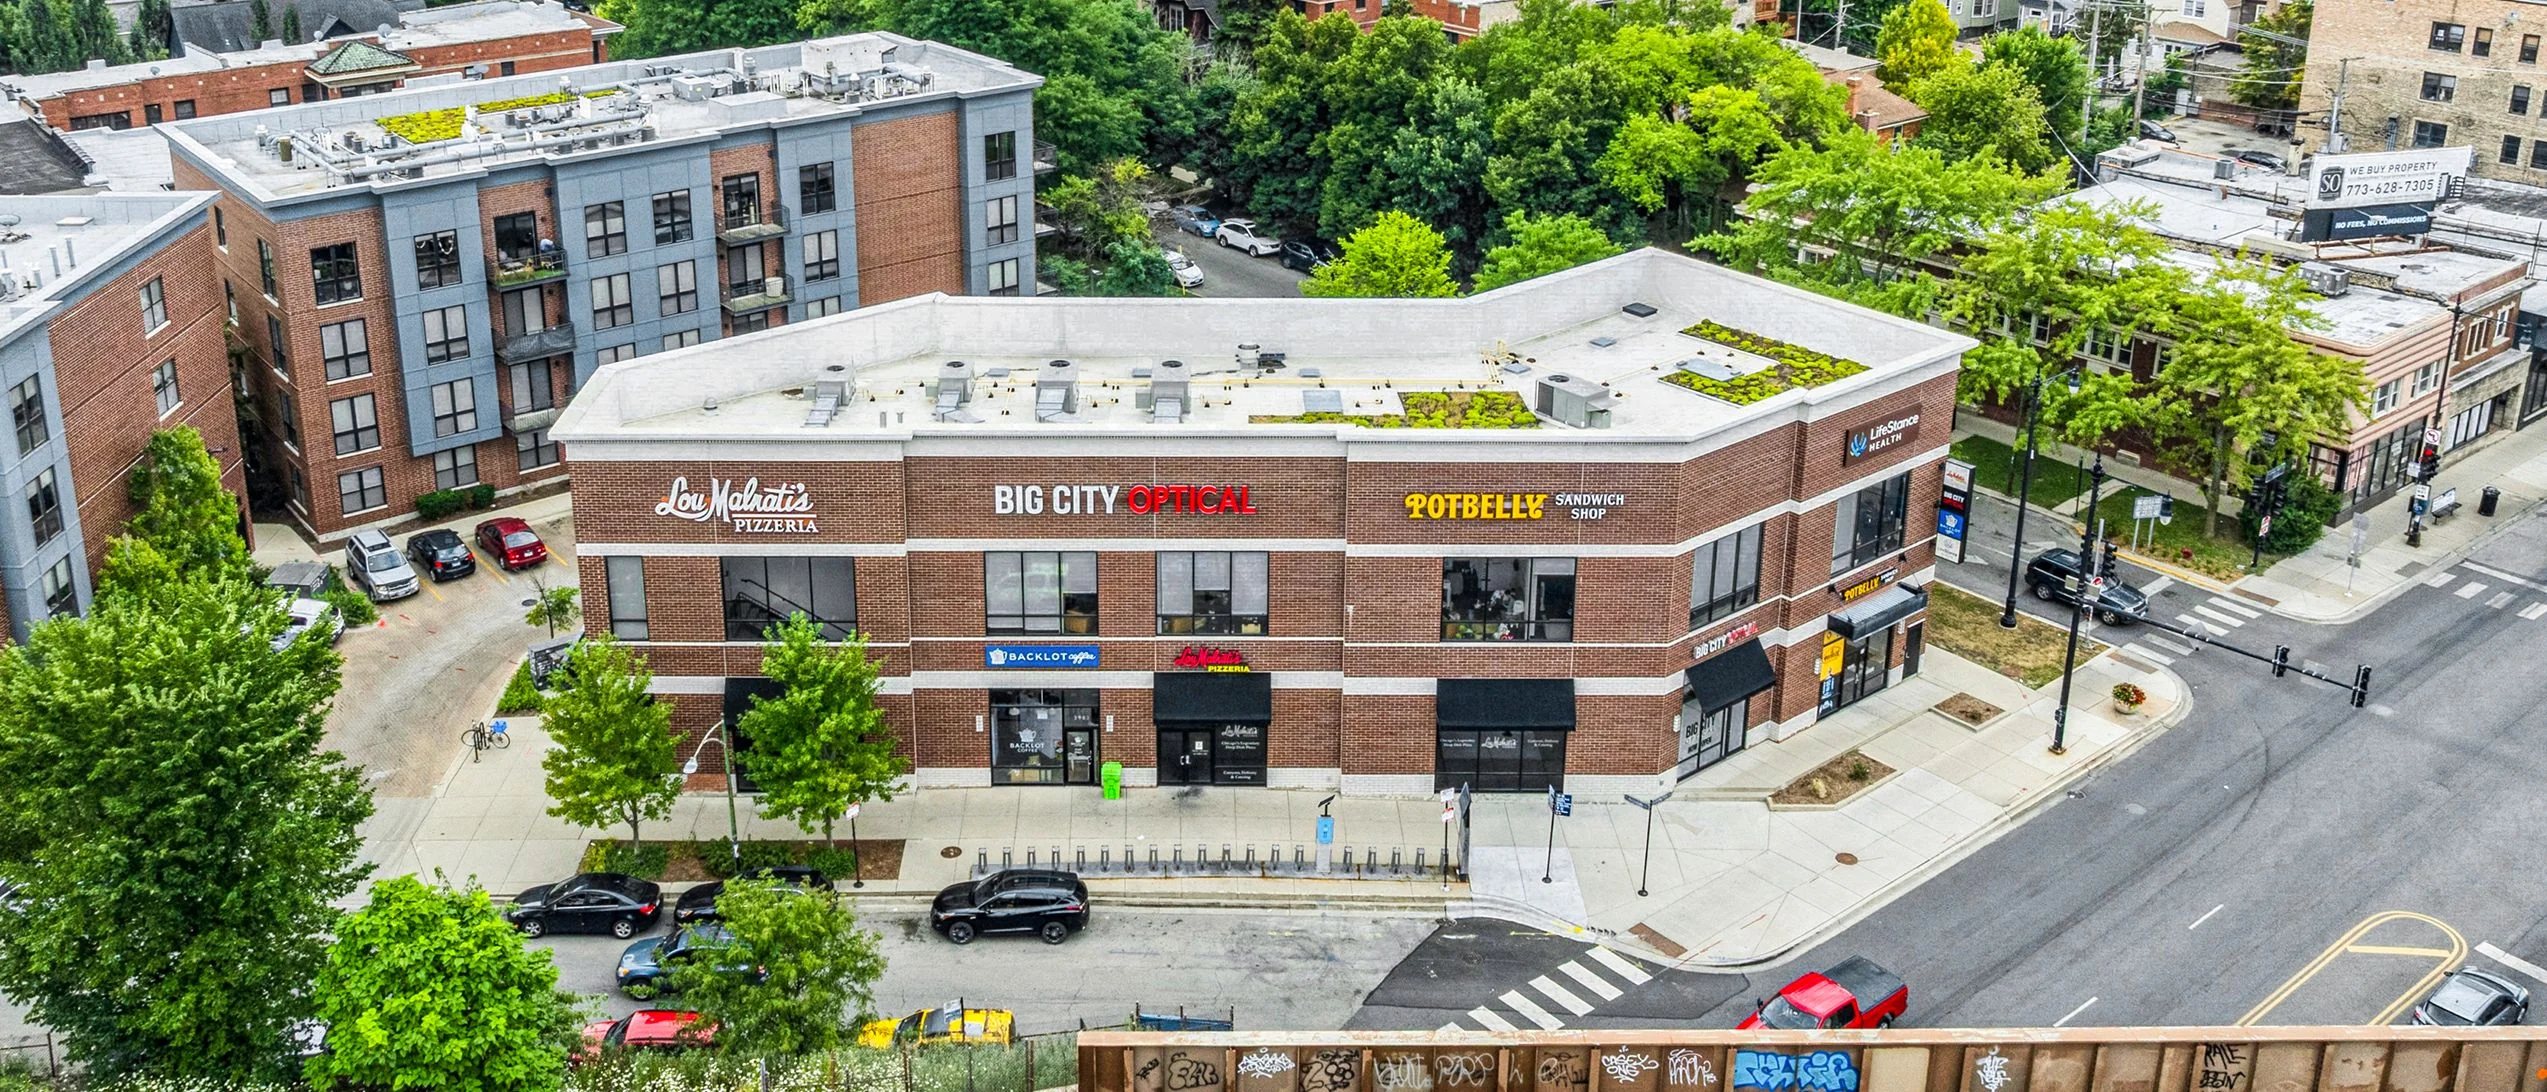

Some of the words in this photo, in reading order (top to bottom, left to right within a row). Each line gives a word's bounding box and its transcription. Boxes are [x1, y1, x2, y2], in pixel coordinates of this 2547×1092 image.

[2350, 166, 2365, 175] WE
[2367, 164, 2386, 174] BUY
[2388, 161, 2438, 173] PROPERTY
[2320, 173, 2340, 193] SO
[2346, 179, 2434, 196] 773-628-7305
[2335, 221, 2346, 229] NO
[2379, 215, 2427, 225] COMMISSIONS
[1870, 414, 1919, 440] LifeStance
[1869, 432, 1902, 452] HEALTH
[655, 476, 709, 520] Lou
[695, 476, 814, 523] Malnati's
[995, 485, 1044, 514] BIG
[1053, 485, 1120, 514] CITY
[1127, 484, 1257, 515] OPTICAL
[1404, 493, 1548, 519] POTBELLY
[1555, 494, 1624, 506] SANDWICH
[1571, 508, 1606, 519] SHOP
[734, 519, 819, 533] PIZZERIA
[1844, 576, 1880, 601] POTBELLY
[1693, 643, 1709, 659] BIG
[1709, 634, 1727, 653] CITY
[1009, 652, 1068, 661] BACKLOT
[1068, 651, 1096, 664] coffee
[1207, 665, 1250, 673] PIZZERIA
[1686, 721, 1698, 738] BIG
